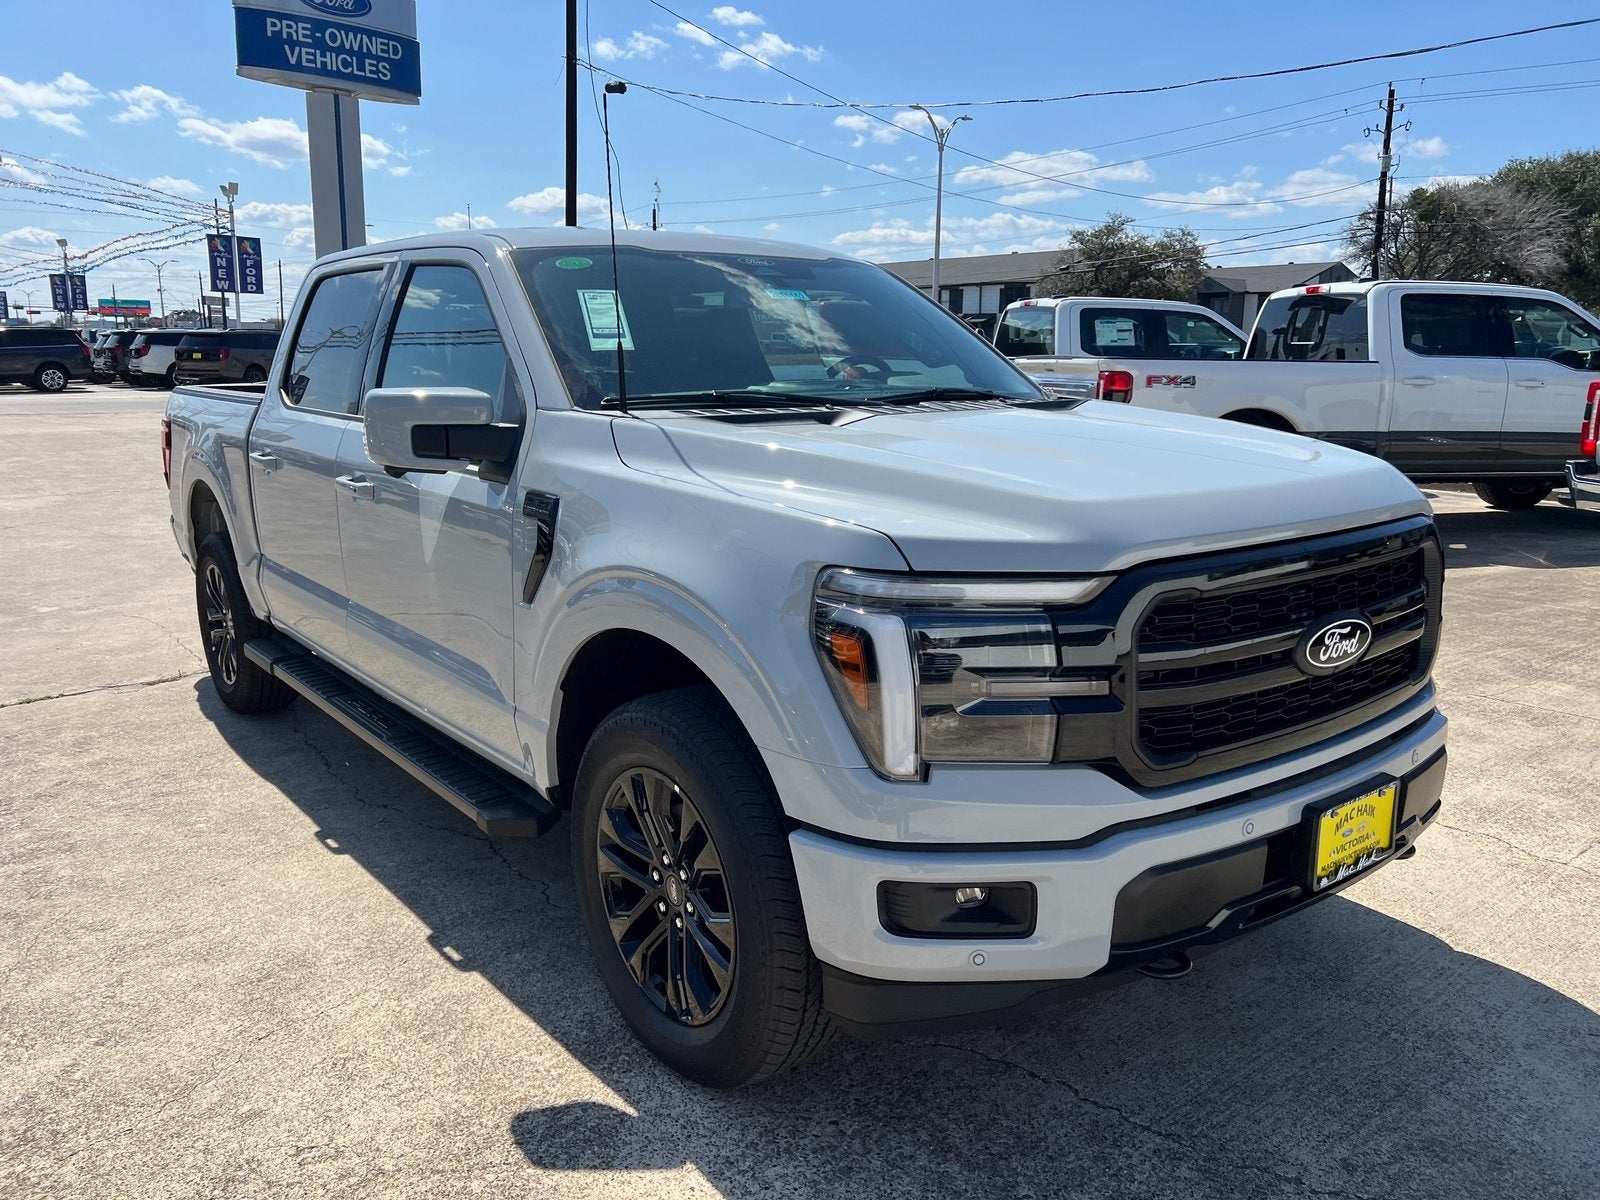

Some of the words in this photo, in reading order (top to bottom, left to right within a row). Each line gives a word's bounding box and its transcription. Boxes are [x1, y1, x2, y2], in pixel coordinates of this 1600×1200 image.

[314, 0, 355, 10] ord
[283, 44, 391, 81] VEHICLES
[216, 257, 229, 290] NEW
[245, 259, 256, 292] FORD
[55, 288, 65, 309] NEW
[75, 288, 84, 309] FORD
[1145, 374, 1197, 389] FX4
[1320, 626, 1360, 661] Ford
[1334, 807, 1355, 836] MAC
[1356, 803, 1376, 819] HAIK
[1334, 832, 1370, 855] VICTORIA
